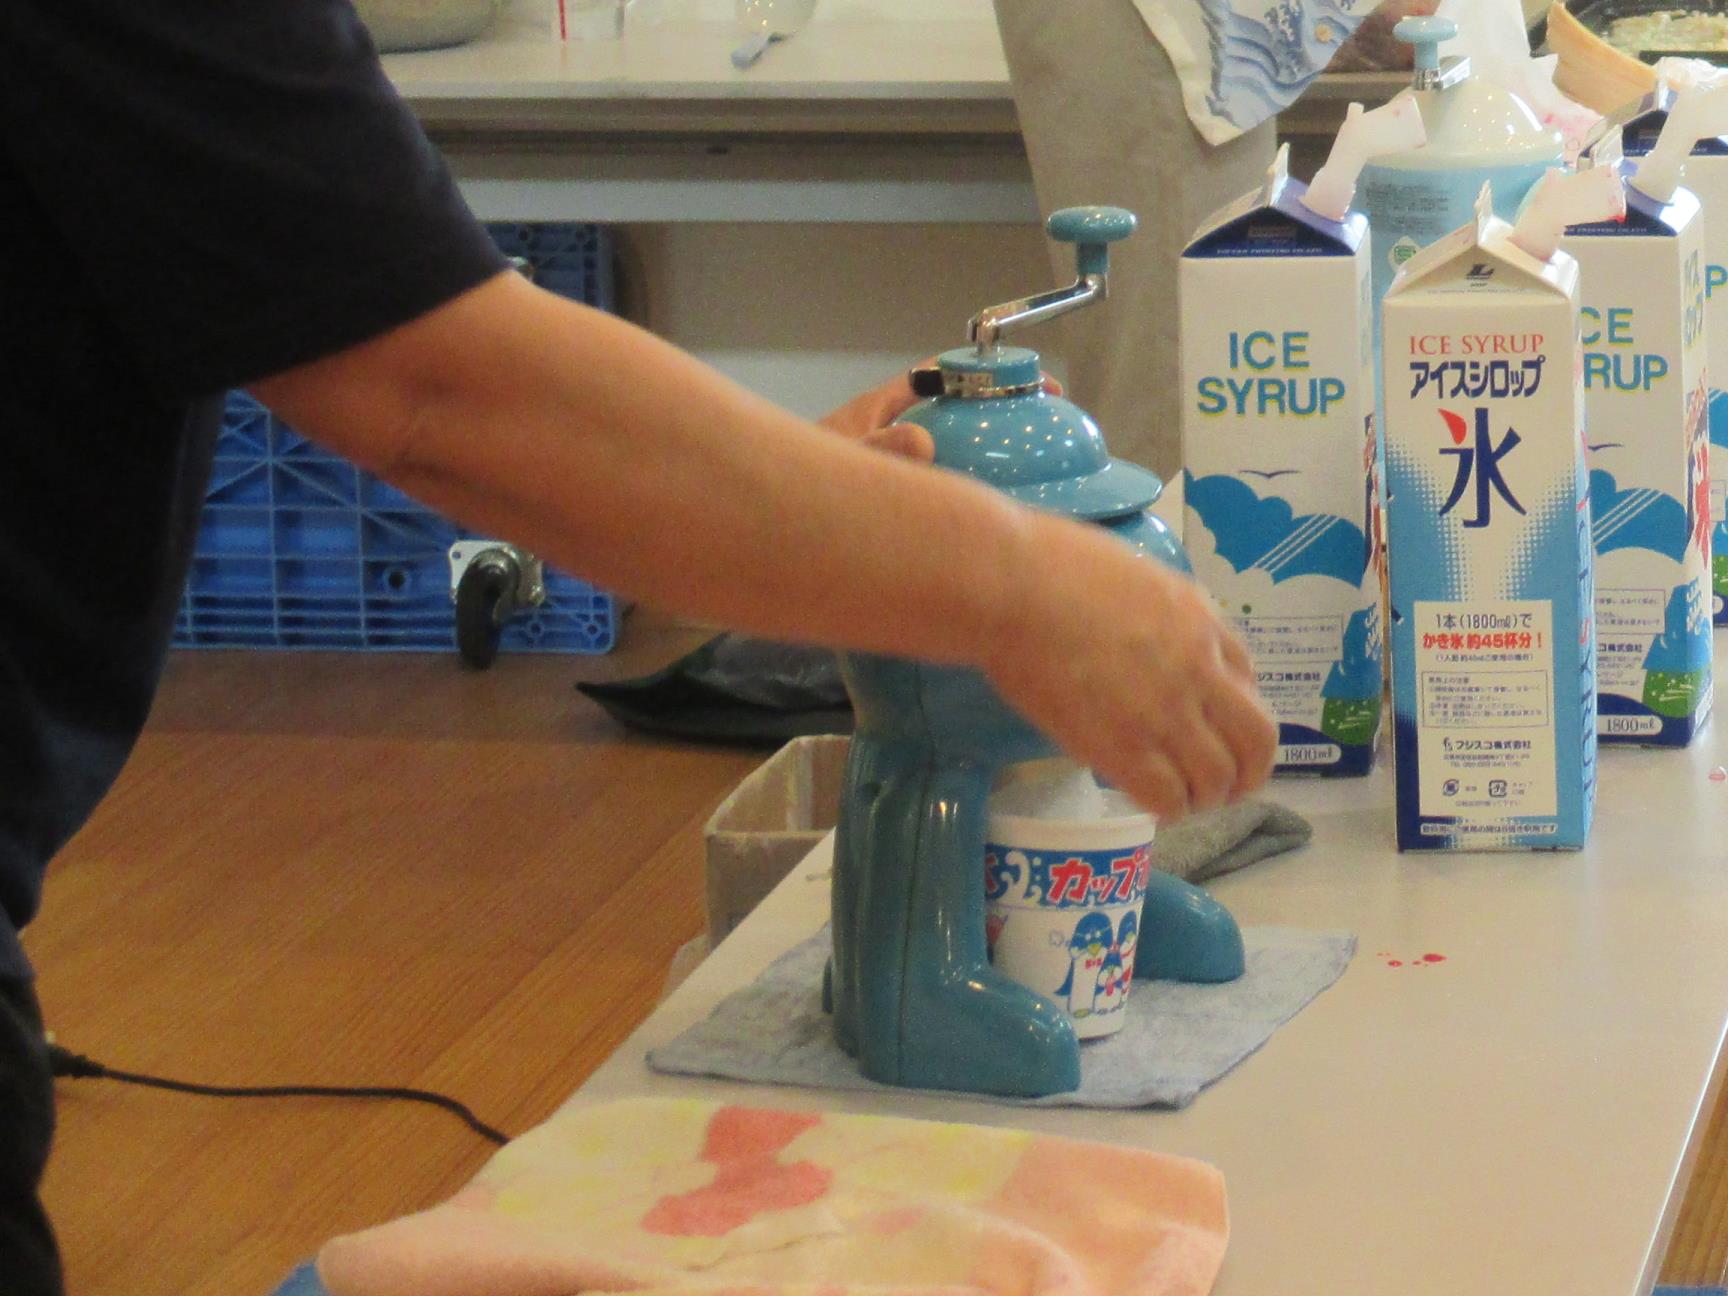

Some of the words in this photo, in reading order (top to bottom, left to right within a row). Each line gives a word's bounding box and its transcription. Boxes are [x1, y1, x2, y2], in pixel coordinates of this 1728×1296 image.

[1410, 334, 1451, 355] ICE
[1461, 333, 1545, 355] SYRUP
[1581, 306, 1634, 344] CE
[1229, 330, 1311, 371] ICE
[1410, 355, 1546, 399] アイスシロップ
[1583, 352, 1668, 391] RUP
[1197, 376, 1346, 417] SYRUP
[1438, 407, 1527, 528] 氷
